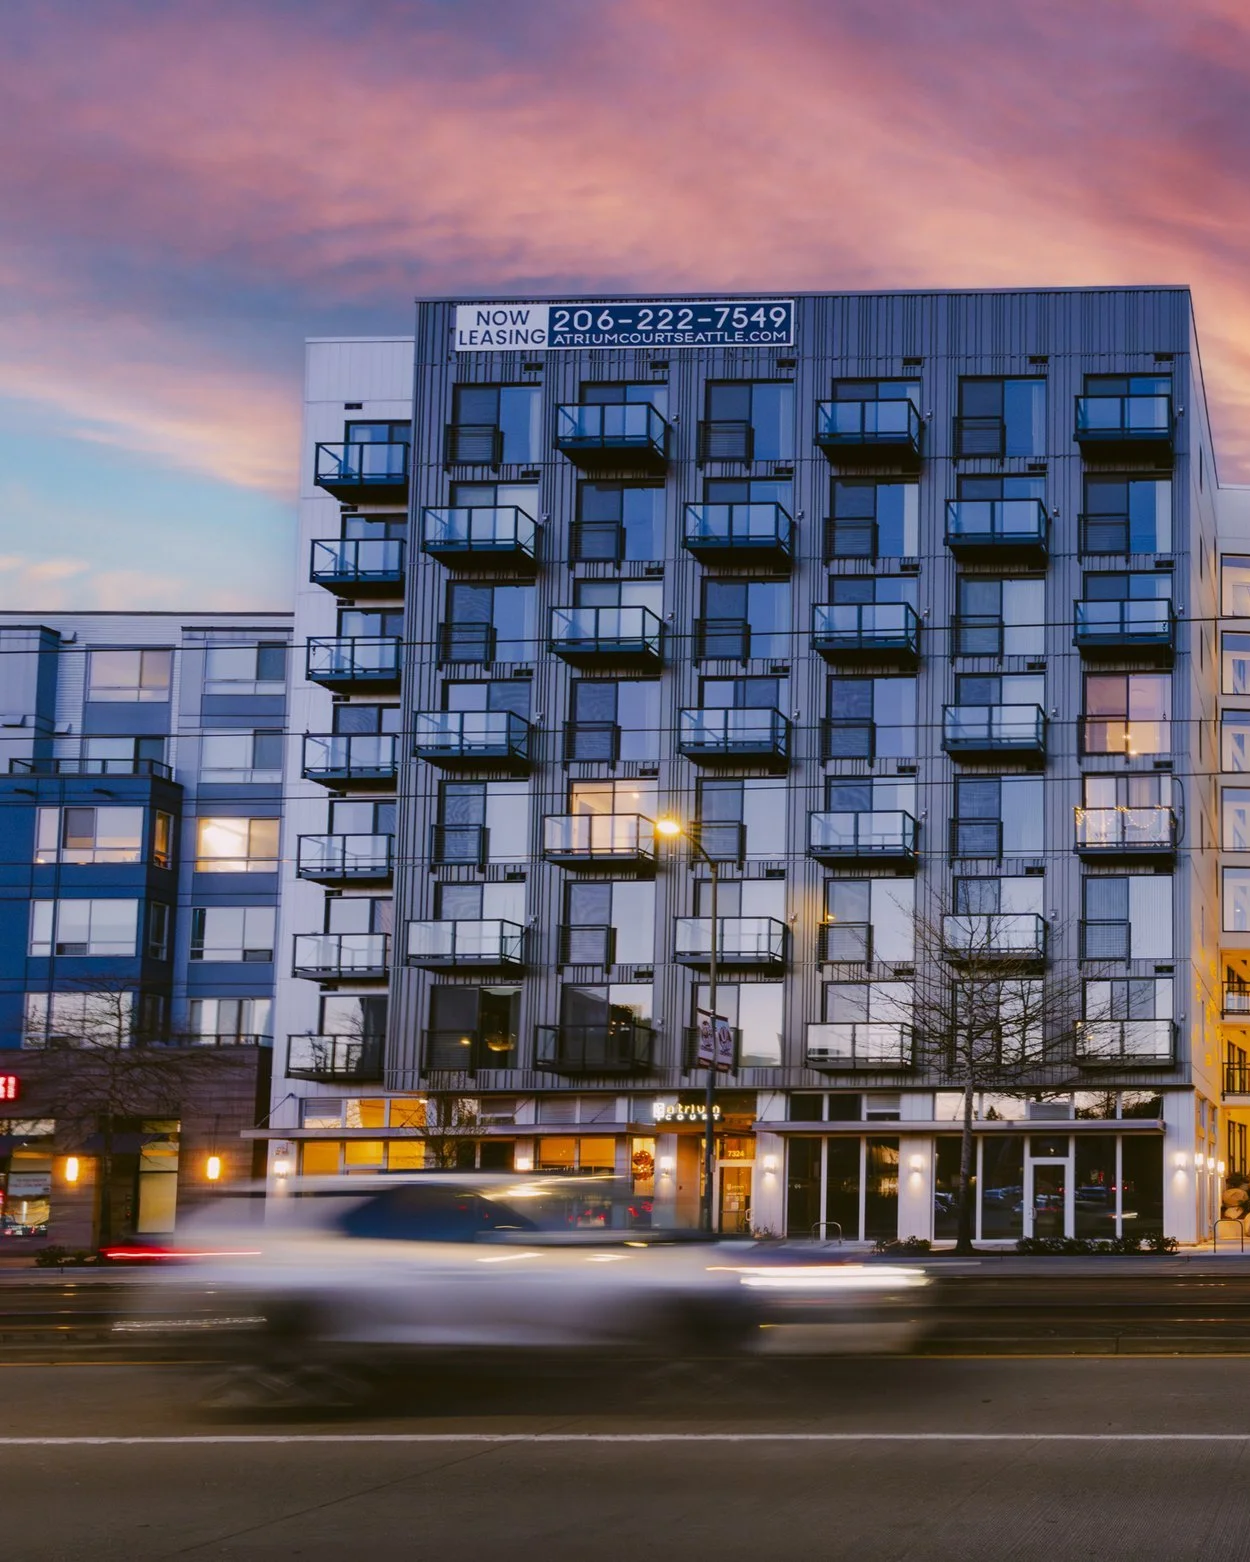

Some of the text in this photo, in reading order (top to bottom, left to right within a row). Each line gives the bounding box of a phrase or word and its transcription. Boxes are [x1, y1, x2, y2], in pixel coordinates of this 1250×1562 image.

[476, 310, 530, 326] NOW
[553, 307, 787, 331] 206-222-7549
[459, 329, 546, 345] LEASING
[553, 331, 787, 345] ATRIUMCOURTSEATTLE.COM
